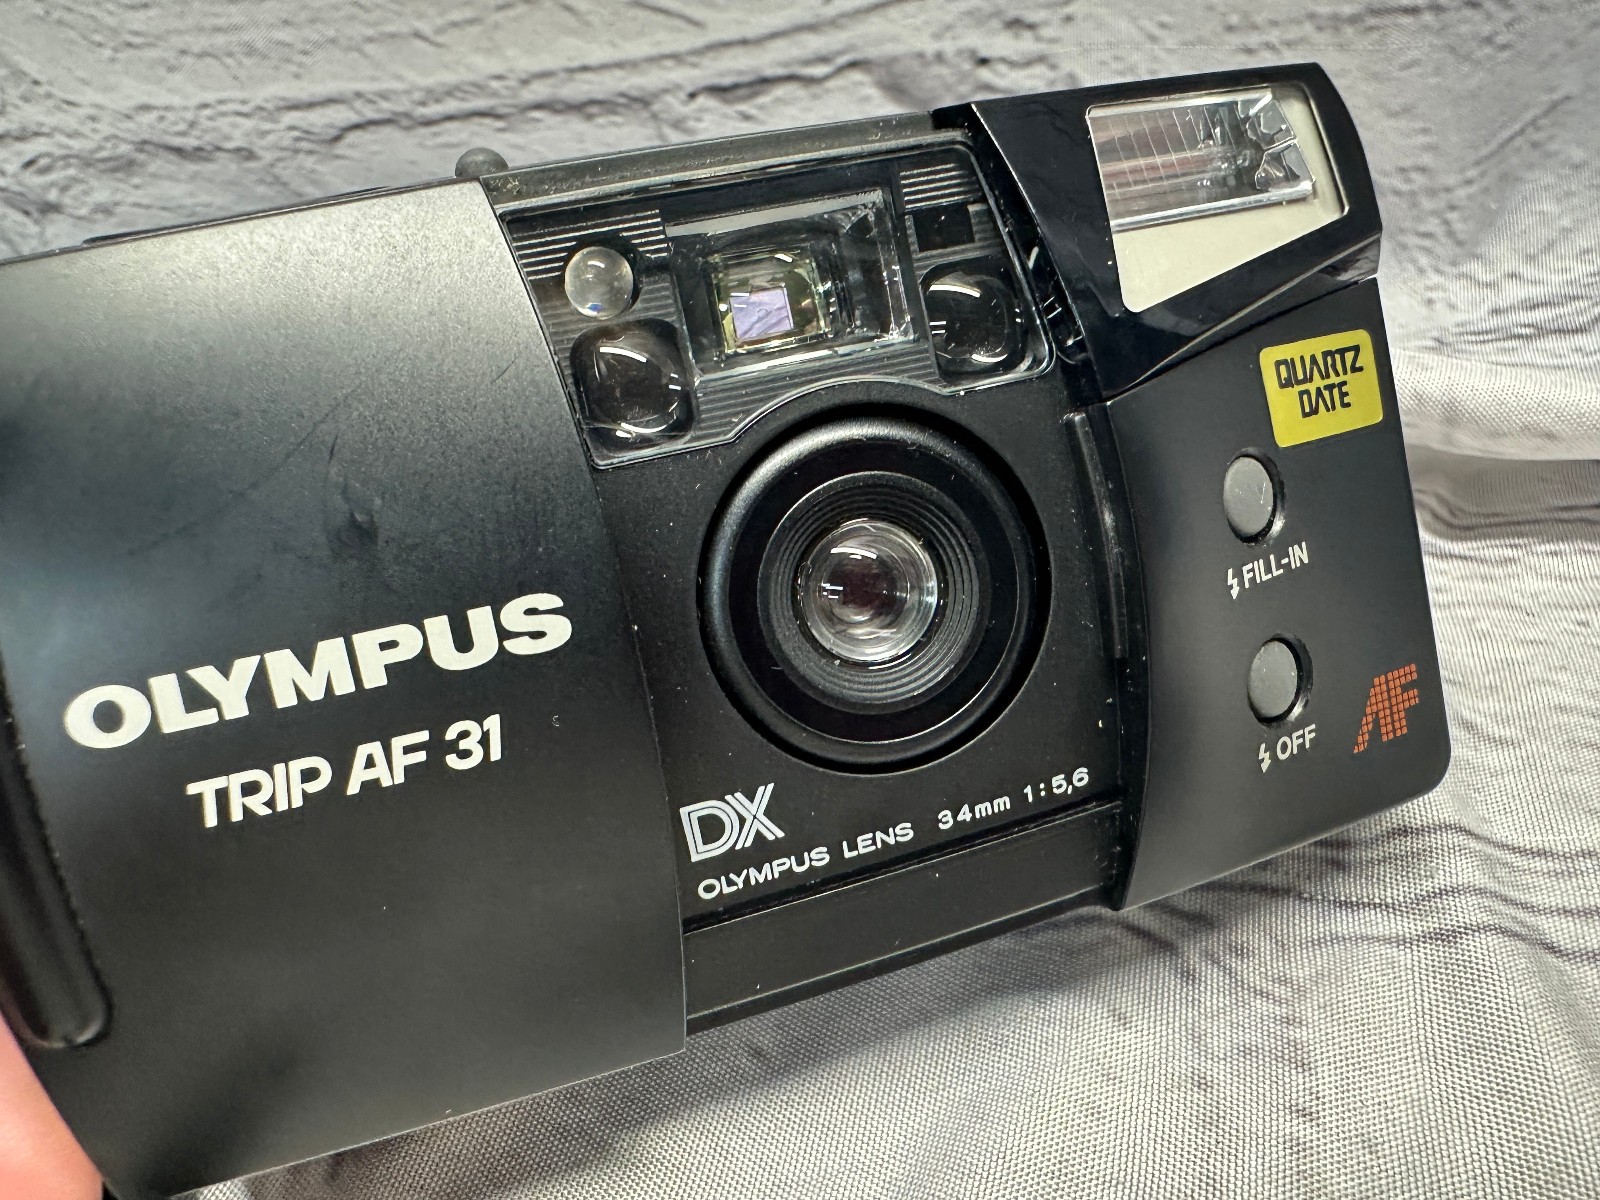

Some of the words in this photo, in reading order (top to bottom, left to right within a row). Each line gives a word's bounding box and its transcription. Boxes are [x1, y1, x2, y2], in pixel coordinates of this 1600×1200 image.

[1274, 344, 1364, 389] QUARTZ
[1298, 381, 1352, 418] DATE
[1241, 541, 1309, 589] FILL-IN
[64, 593, 572, 749] OLYMPUS
[1353, 664, 1419, 753] AF
[186, 755, 332, 829] TRIP
[347, 730, 429, 796] AF
[444, 714, 502, 771] 31
[1276, 724, 1317, 761] OFF
[679, 783, 785, 863] DX
[697, 847, 830, 900] OLYMPUS
[842, 822, 914, 859] LENS
[938, 795, 1011, 830] 34mm
